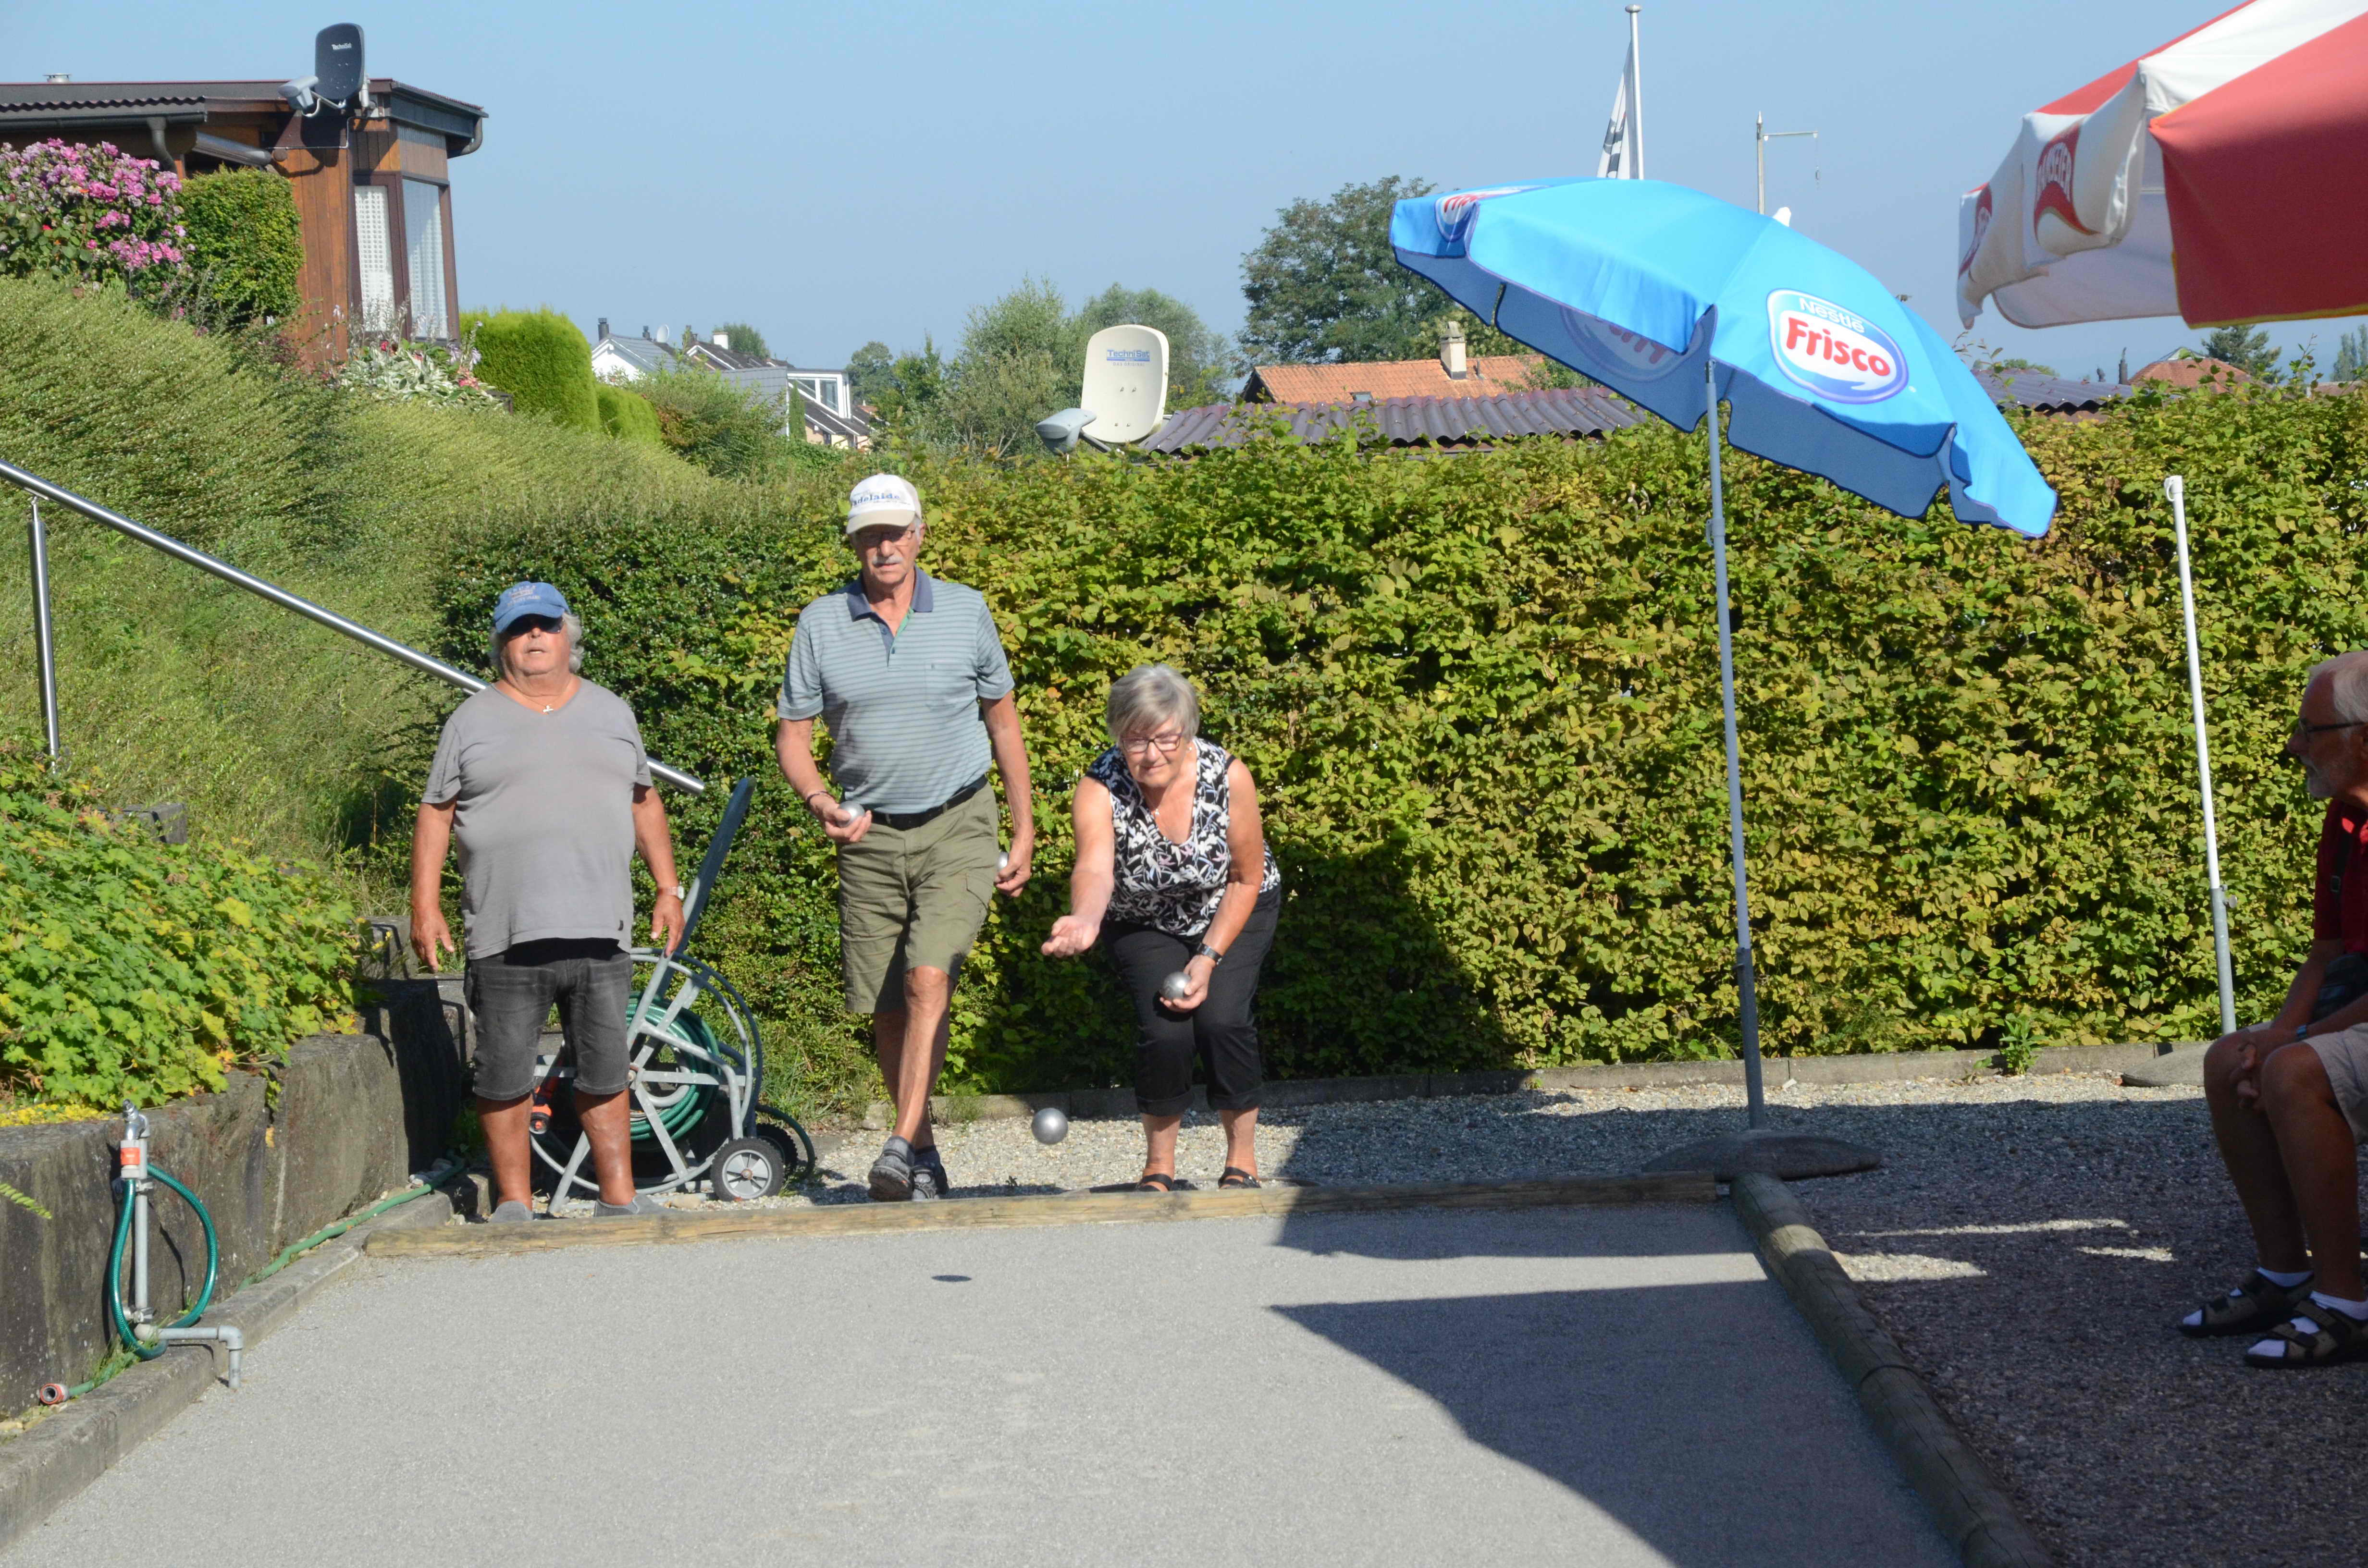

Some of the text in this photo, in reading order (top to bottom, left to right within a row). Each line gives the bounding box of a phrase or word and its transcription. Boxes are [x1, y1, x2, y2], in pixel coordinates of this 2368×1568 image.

[1799, 297, 1865, 333] Nestlé
[1107, 349, 1150, 357] TechniSat
[1786, 317, 1890, 376] Frisco
